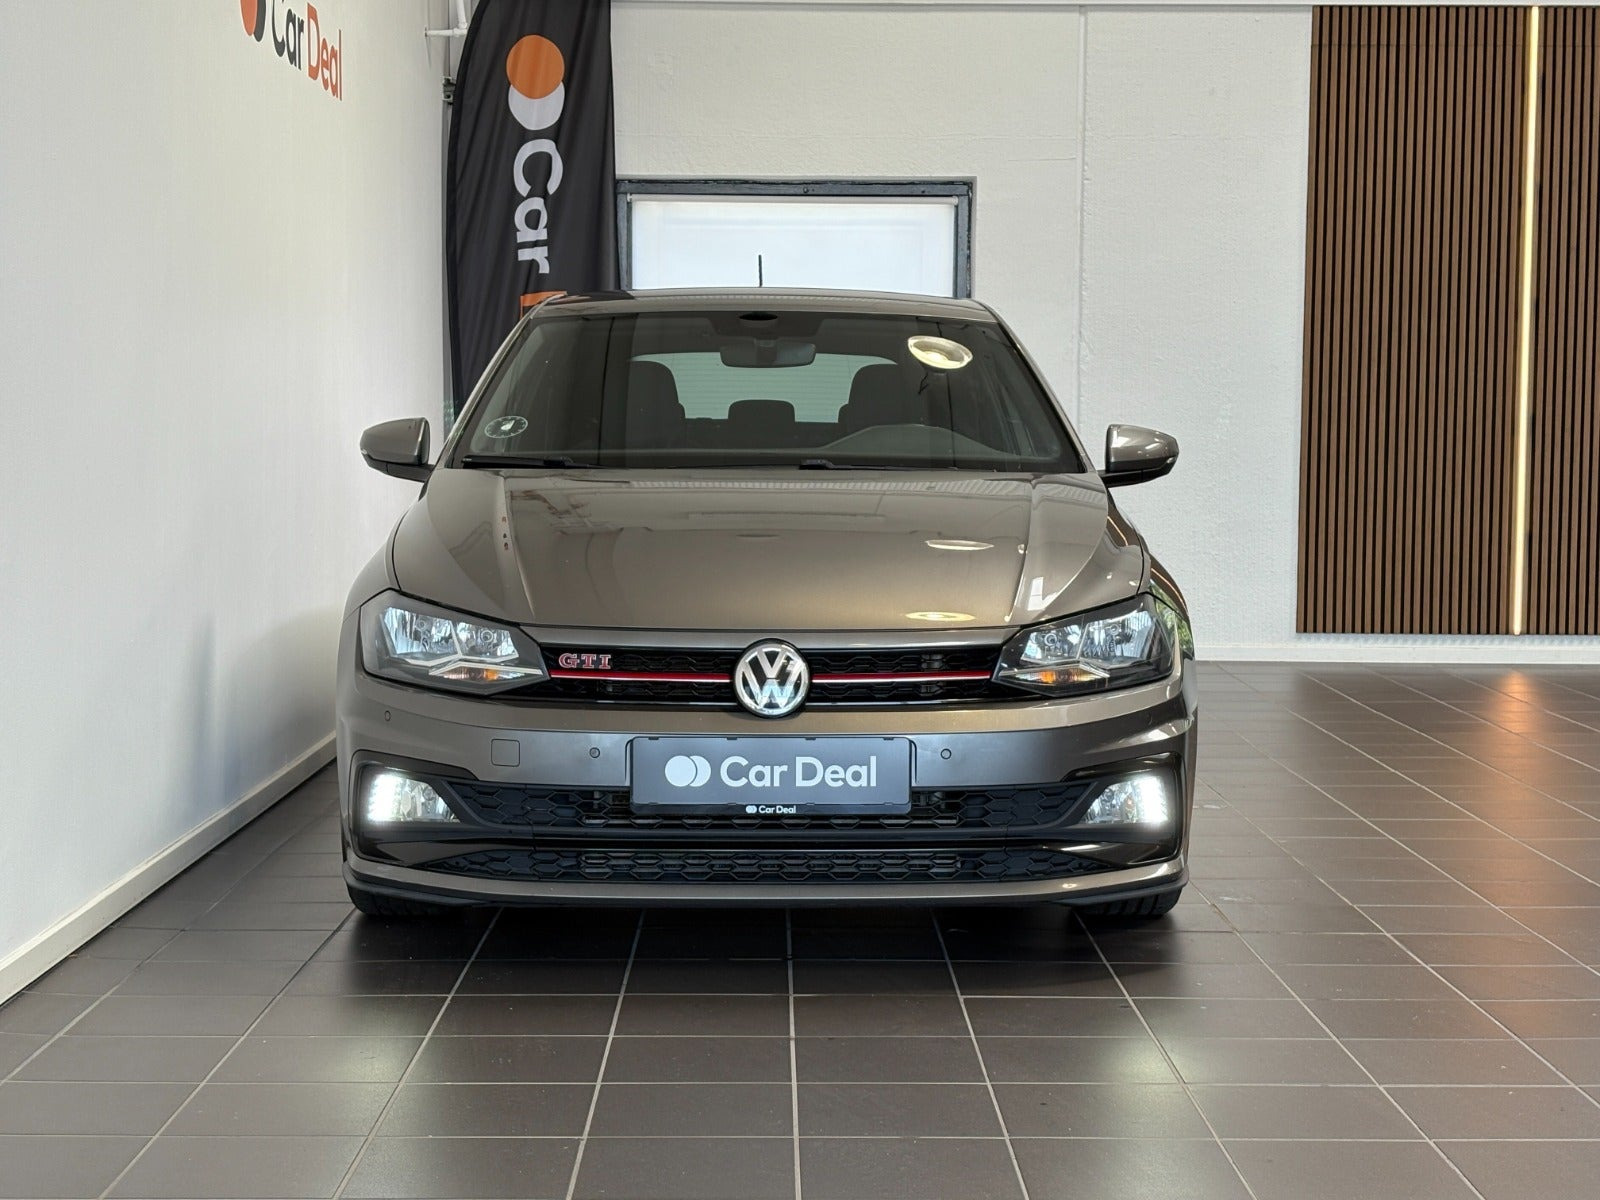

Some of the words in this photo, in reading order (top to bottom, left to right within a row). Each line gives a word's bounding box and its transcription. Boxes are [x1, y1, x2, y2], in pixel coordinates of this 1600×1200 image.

[272, 0, 304, 71] Car
[307, 2, 342, 101] Deal
[513, 138, 563, 274] Car
[558, 652, 611, 669] GTI
[738, 645, 806, 712] VW
[720, 755, 788, 787] Car
[795, 755, 877, 787] Deal
[758, 805, 775, 814] Car
[776, 805, 796, 814] Deal
